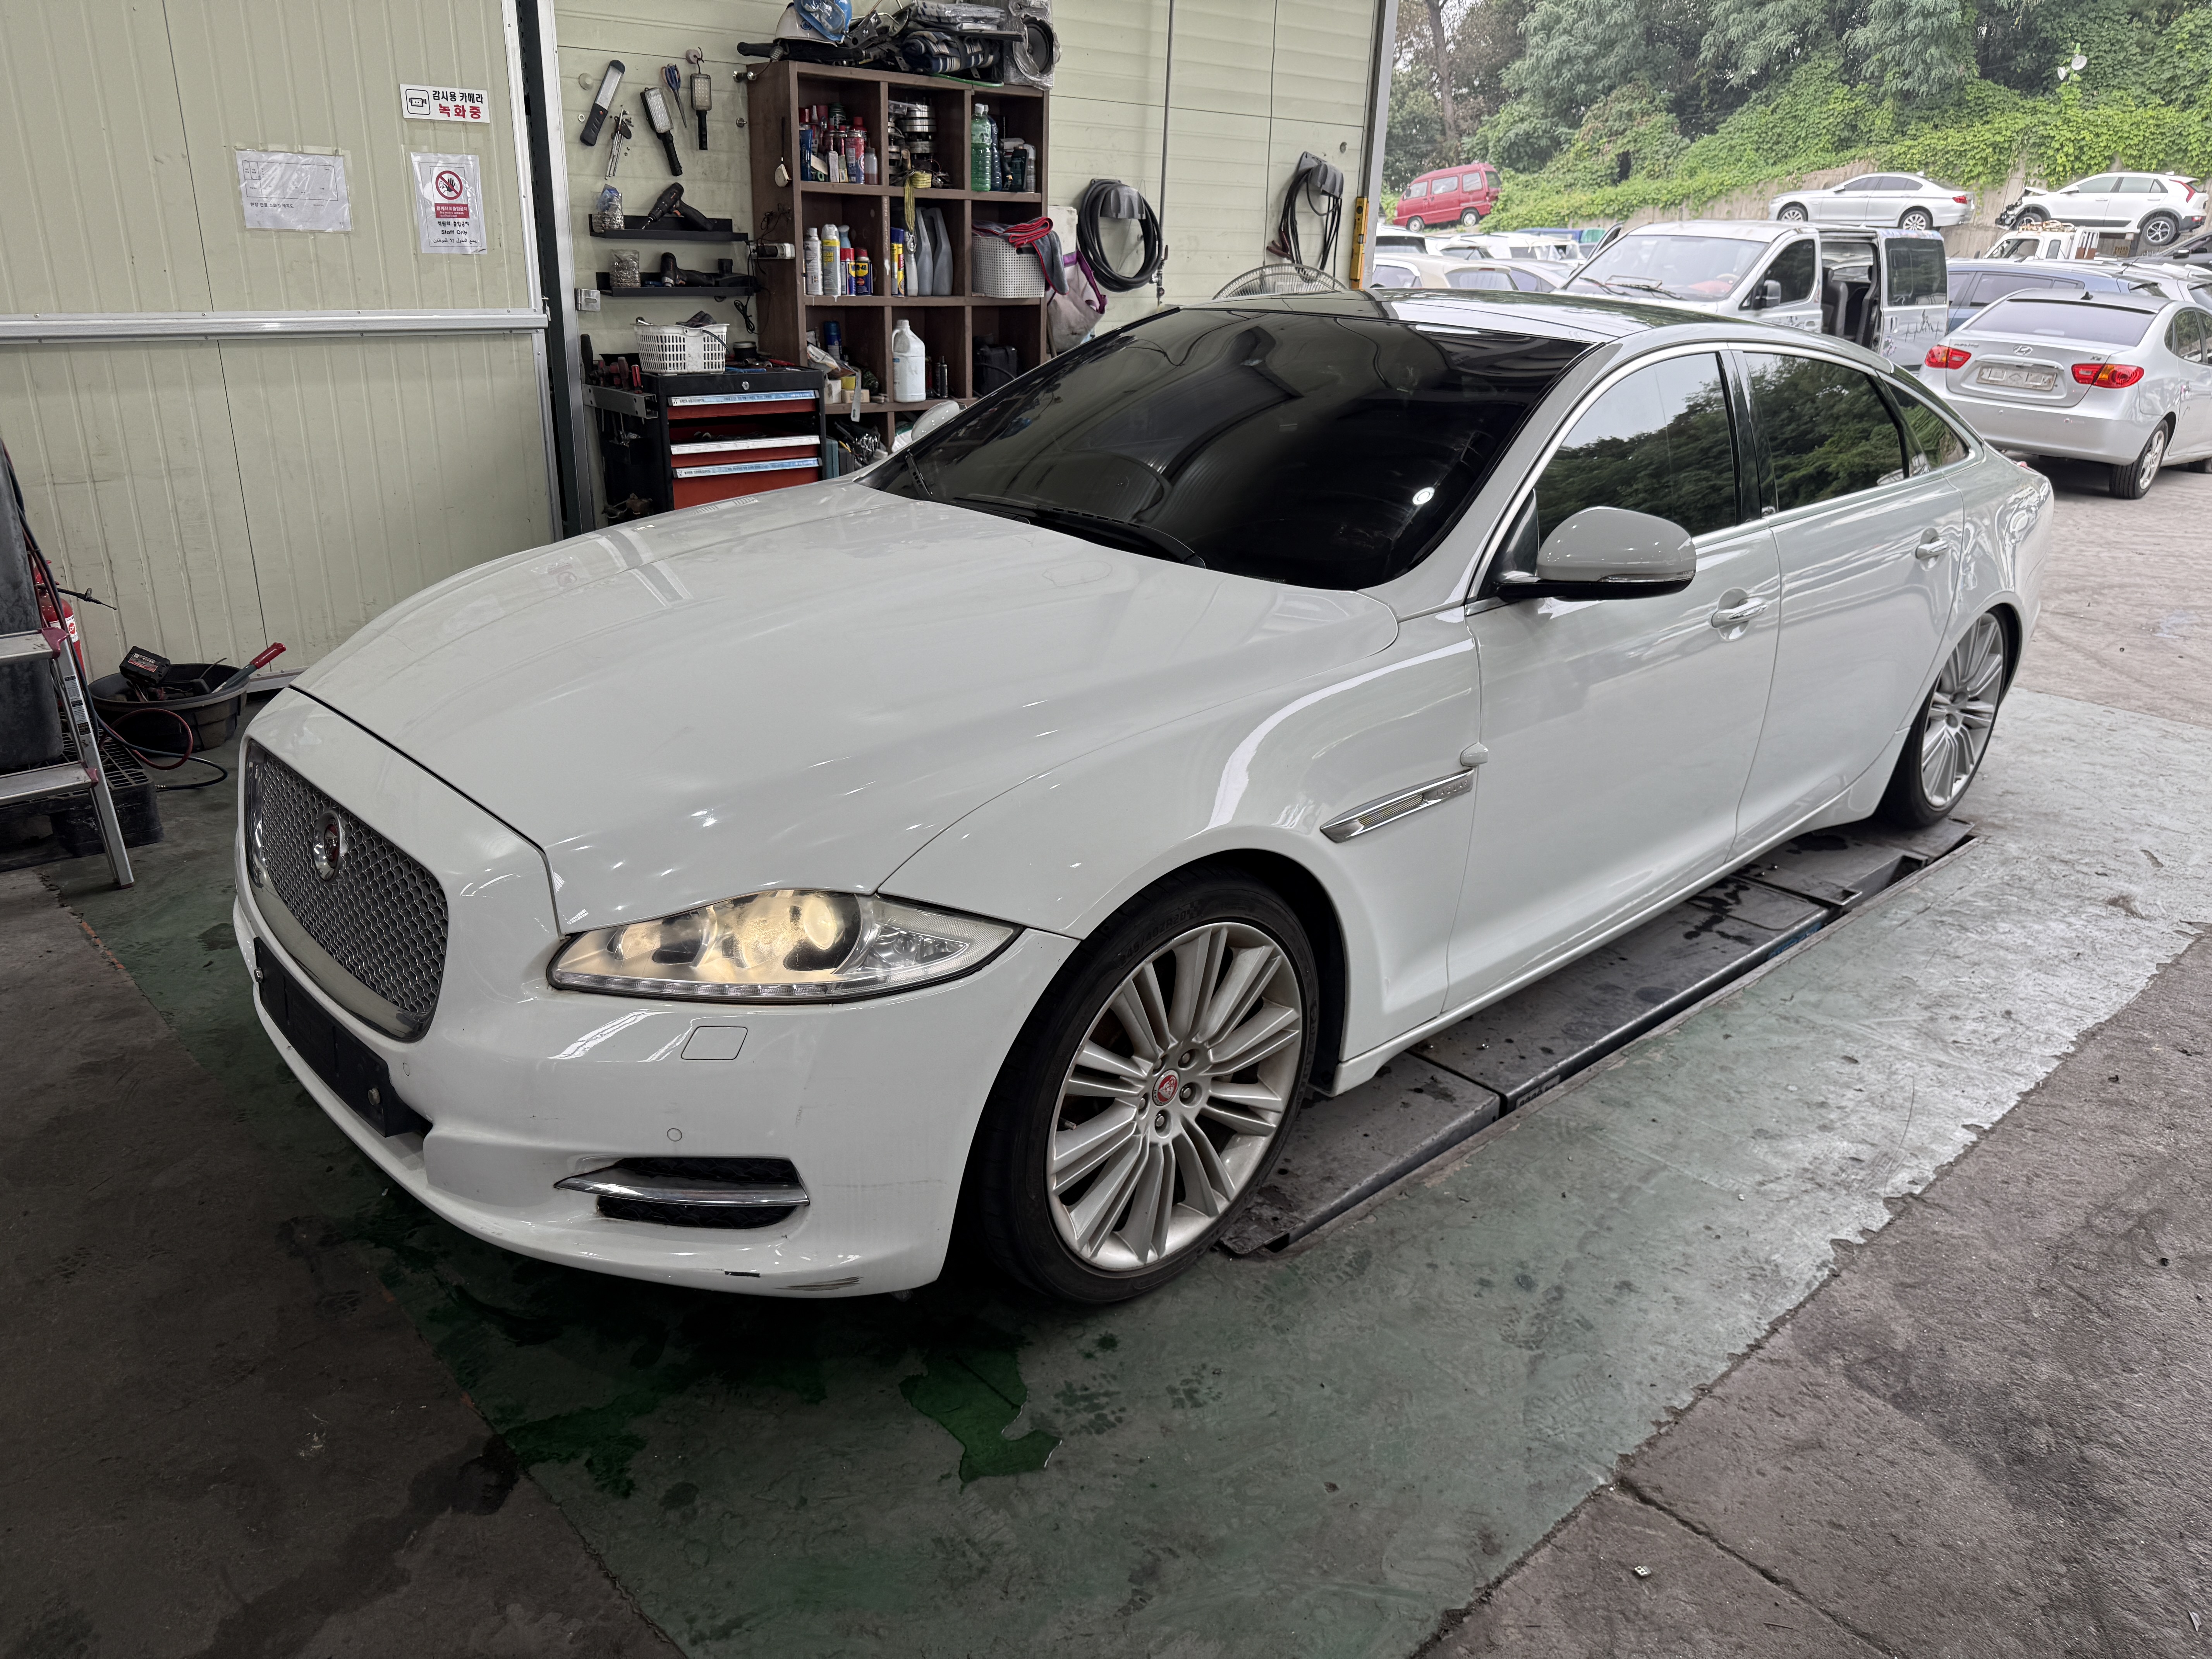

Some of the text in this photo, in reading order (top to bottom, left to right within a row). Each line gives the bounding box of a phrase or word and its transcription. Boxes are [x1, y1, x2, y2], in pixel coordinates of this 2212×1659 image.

[432, 90, 483, 103] 감시용 카메라
[1436, 780, 1468, 797] JAGUAR
